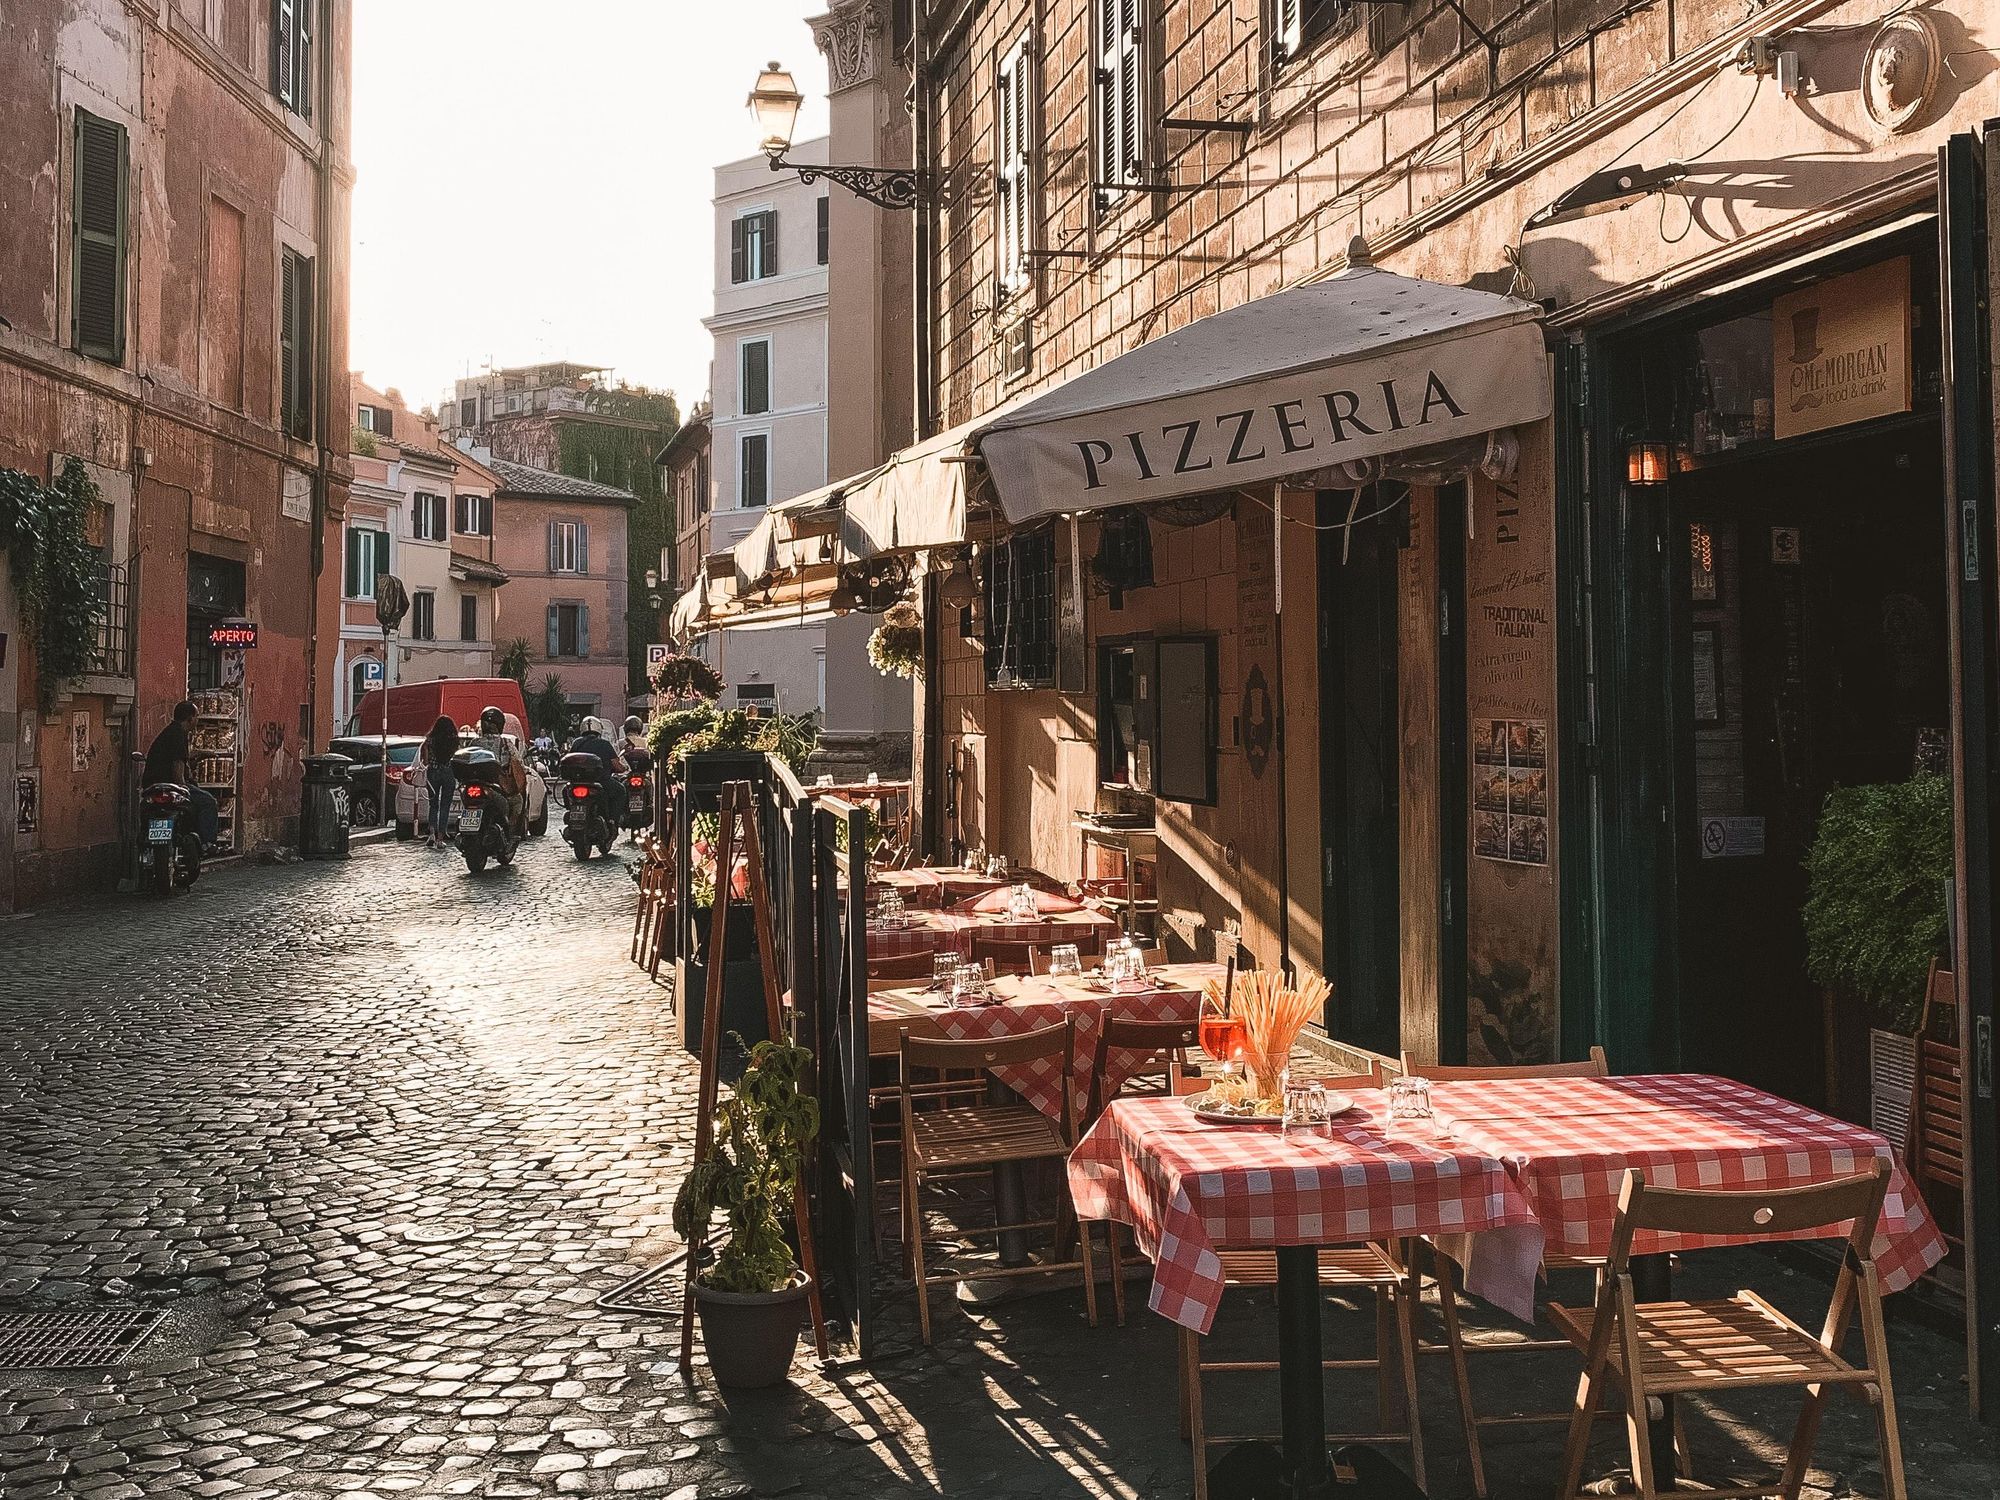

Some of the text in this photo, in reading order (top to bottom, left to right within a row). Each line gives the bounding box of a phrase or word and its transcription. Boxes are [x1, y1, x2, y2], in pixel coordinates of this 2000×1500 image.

[1825, 376, 1887, 405] food & drink
[1070, 370, 1469, 491] PIZZERIA
[1496, 463, 1519, 544] PIZ
[1483, 606, 1548, 624] TRADITIONAL
[211, 629, 254, 643] APERTO
[1495, 622, 1535, 638] ITALIAN
[1474, 648, 1532, 668] extra virgin
[367, 663, 380, 678] P
[1484, 665, 1524, 686] olive oil
